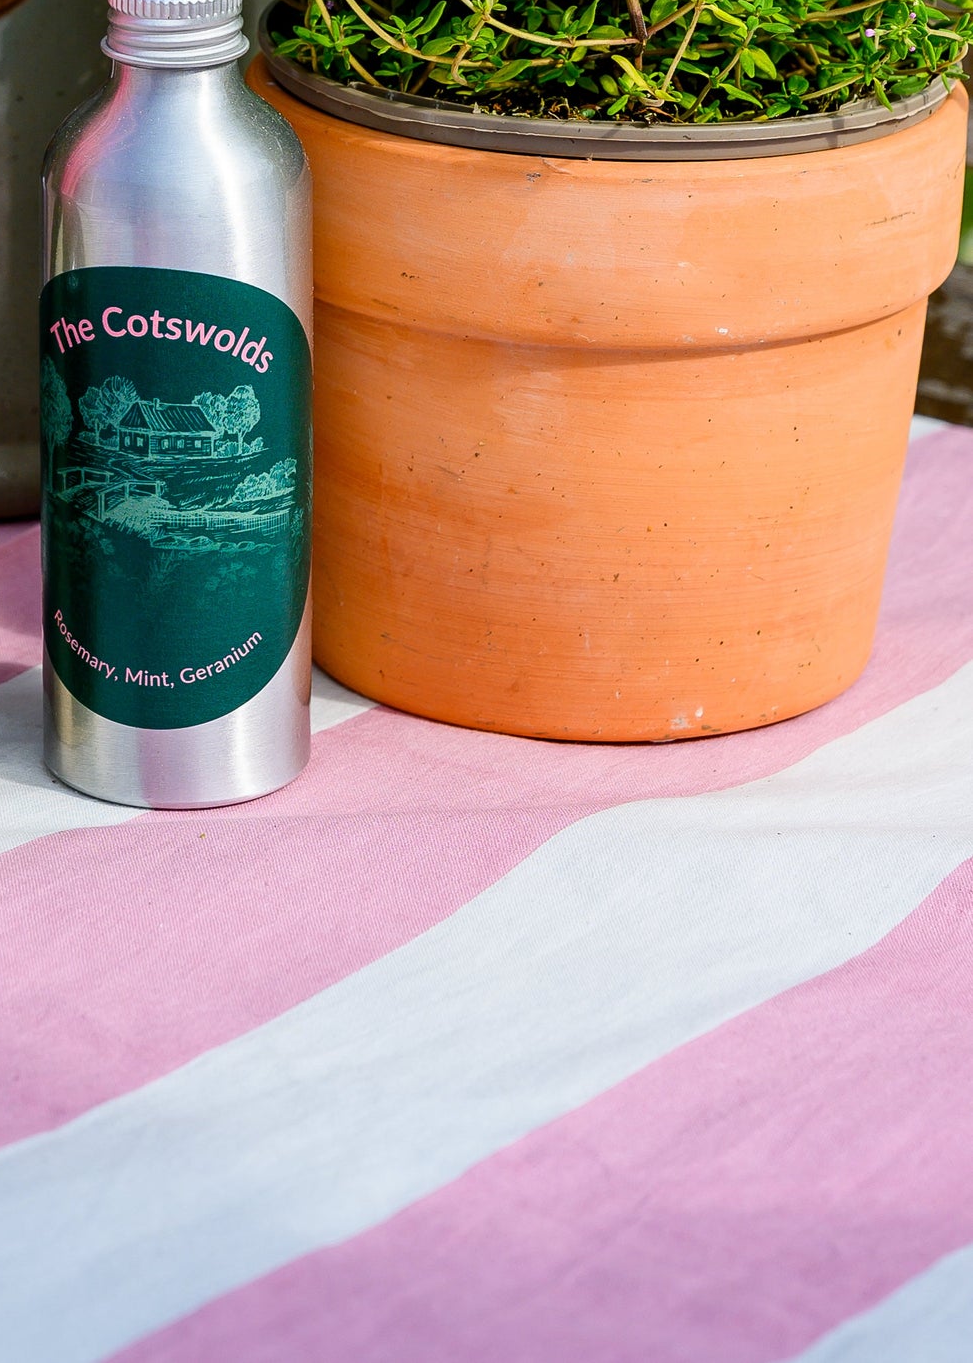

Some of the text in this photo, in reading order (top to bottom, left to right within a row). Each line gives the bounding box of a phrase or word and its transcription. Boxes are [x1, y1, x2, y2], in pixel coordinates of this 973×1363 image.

[50, 306, 274, 374] The Cotswolds
[54, 608, 263, 689] Rosemary, Mint, Geranium
